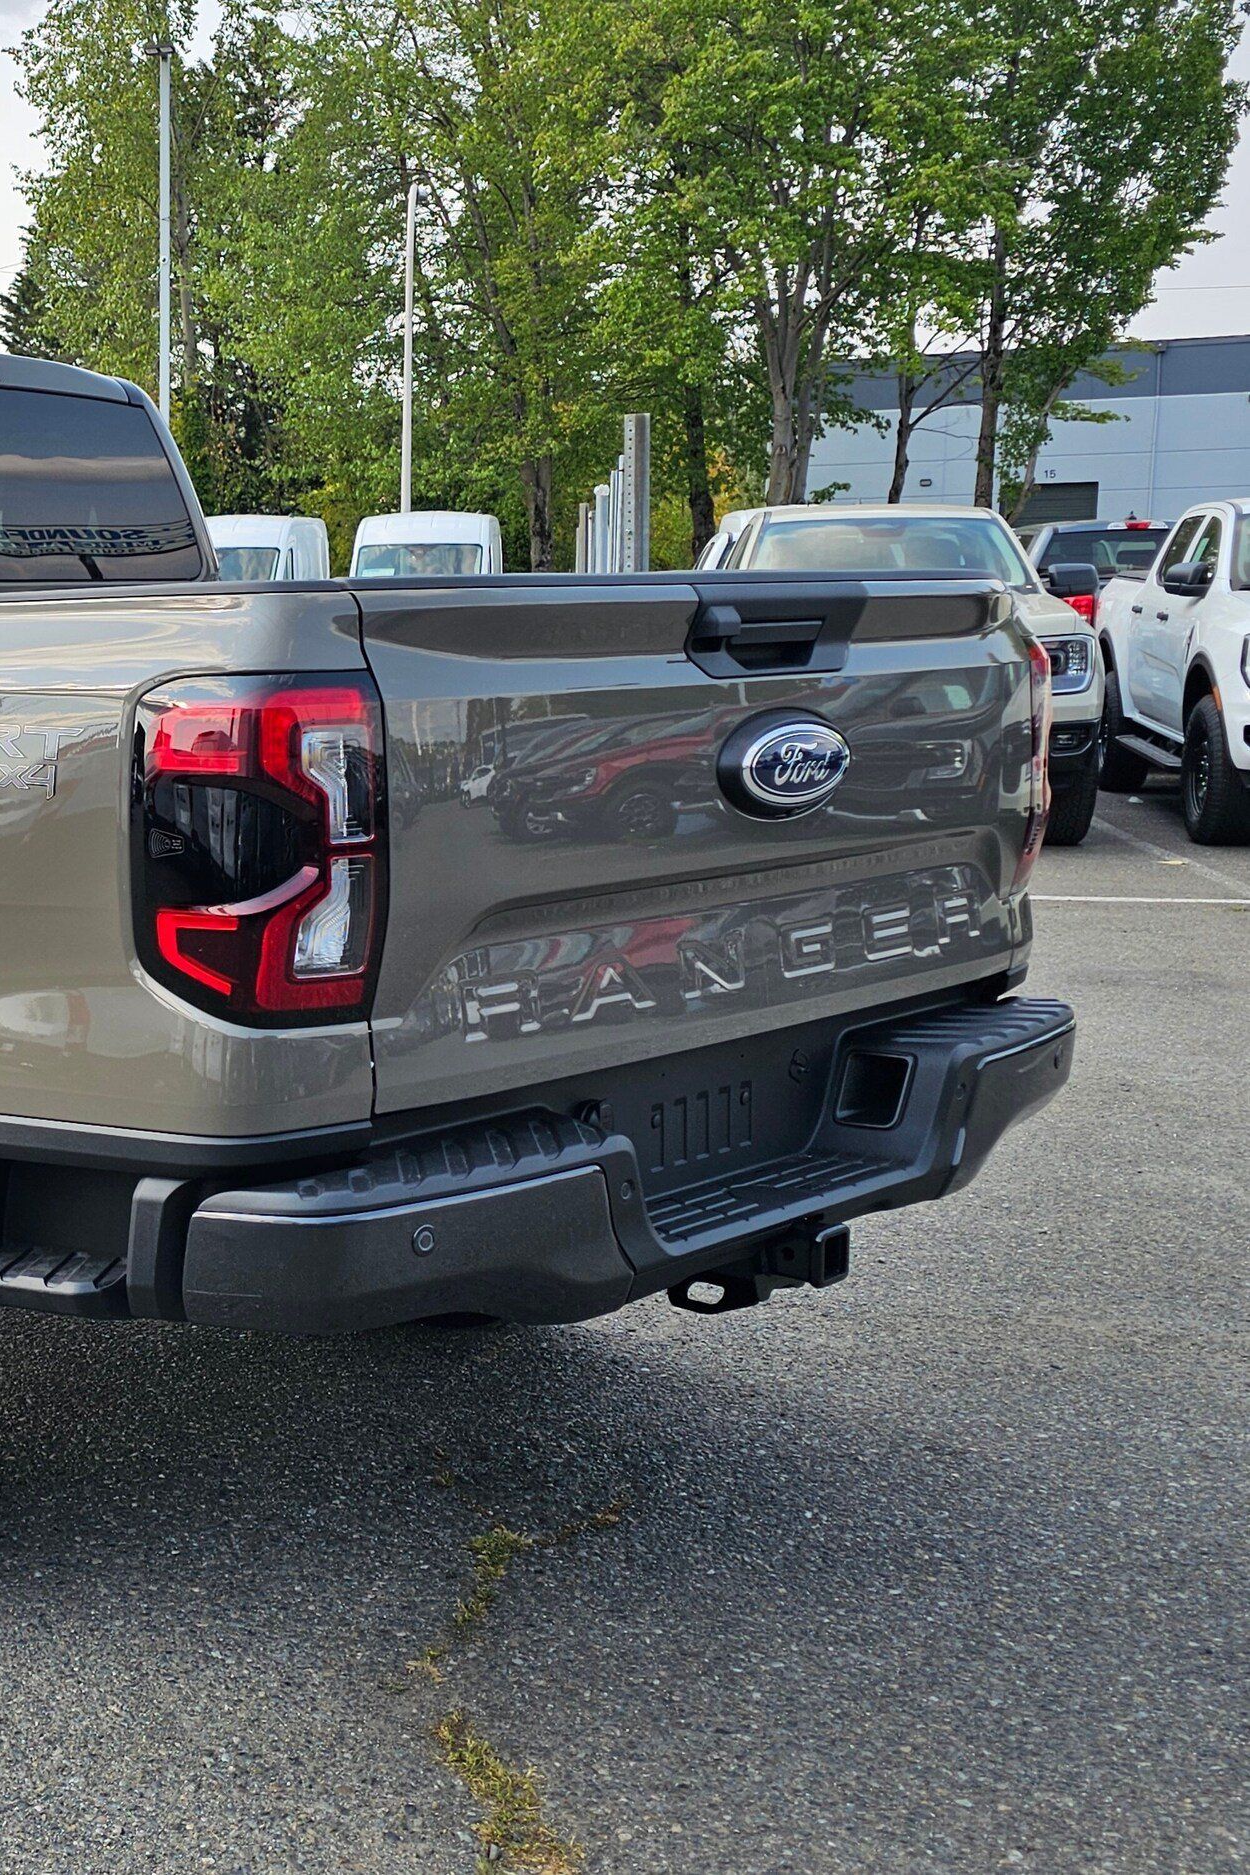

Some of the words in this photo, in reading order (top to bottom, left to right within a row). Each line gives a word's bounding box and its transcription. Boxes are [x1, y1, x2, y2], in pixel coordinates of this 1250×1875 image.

[1044, 469, 1057, 479] 15
[774, 742, 832, 786] Ford
[459, 893, 982, 1043] RANGER
